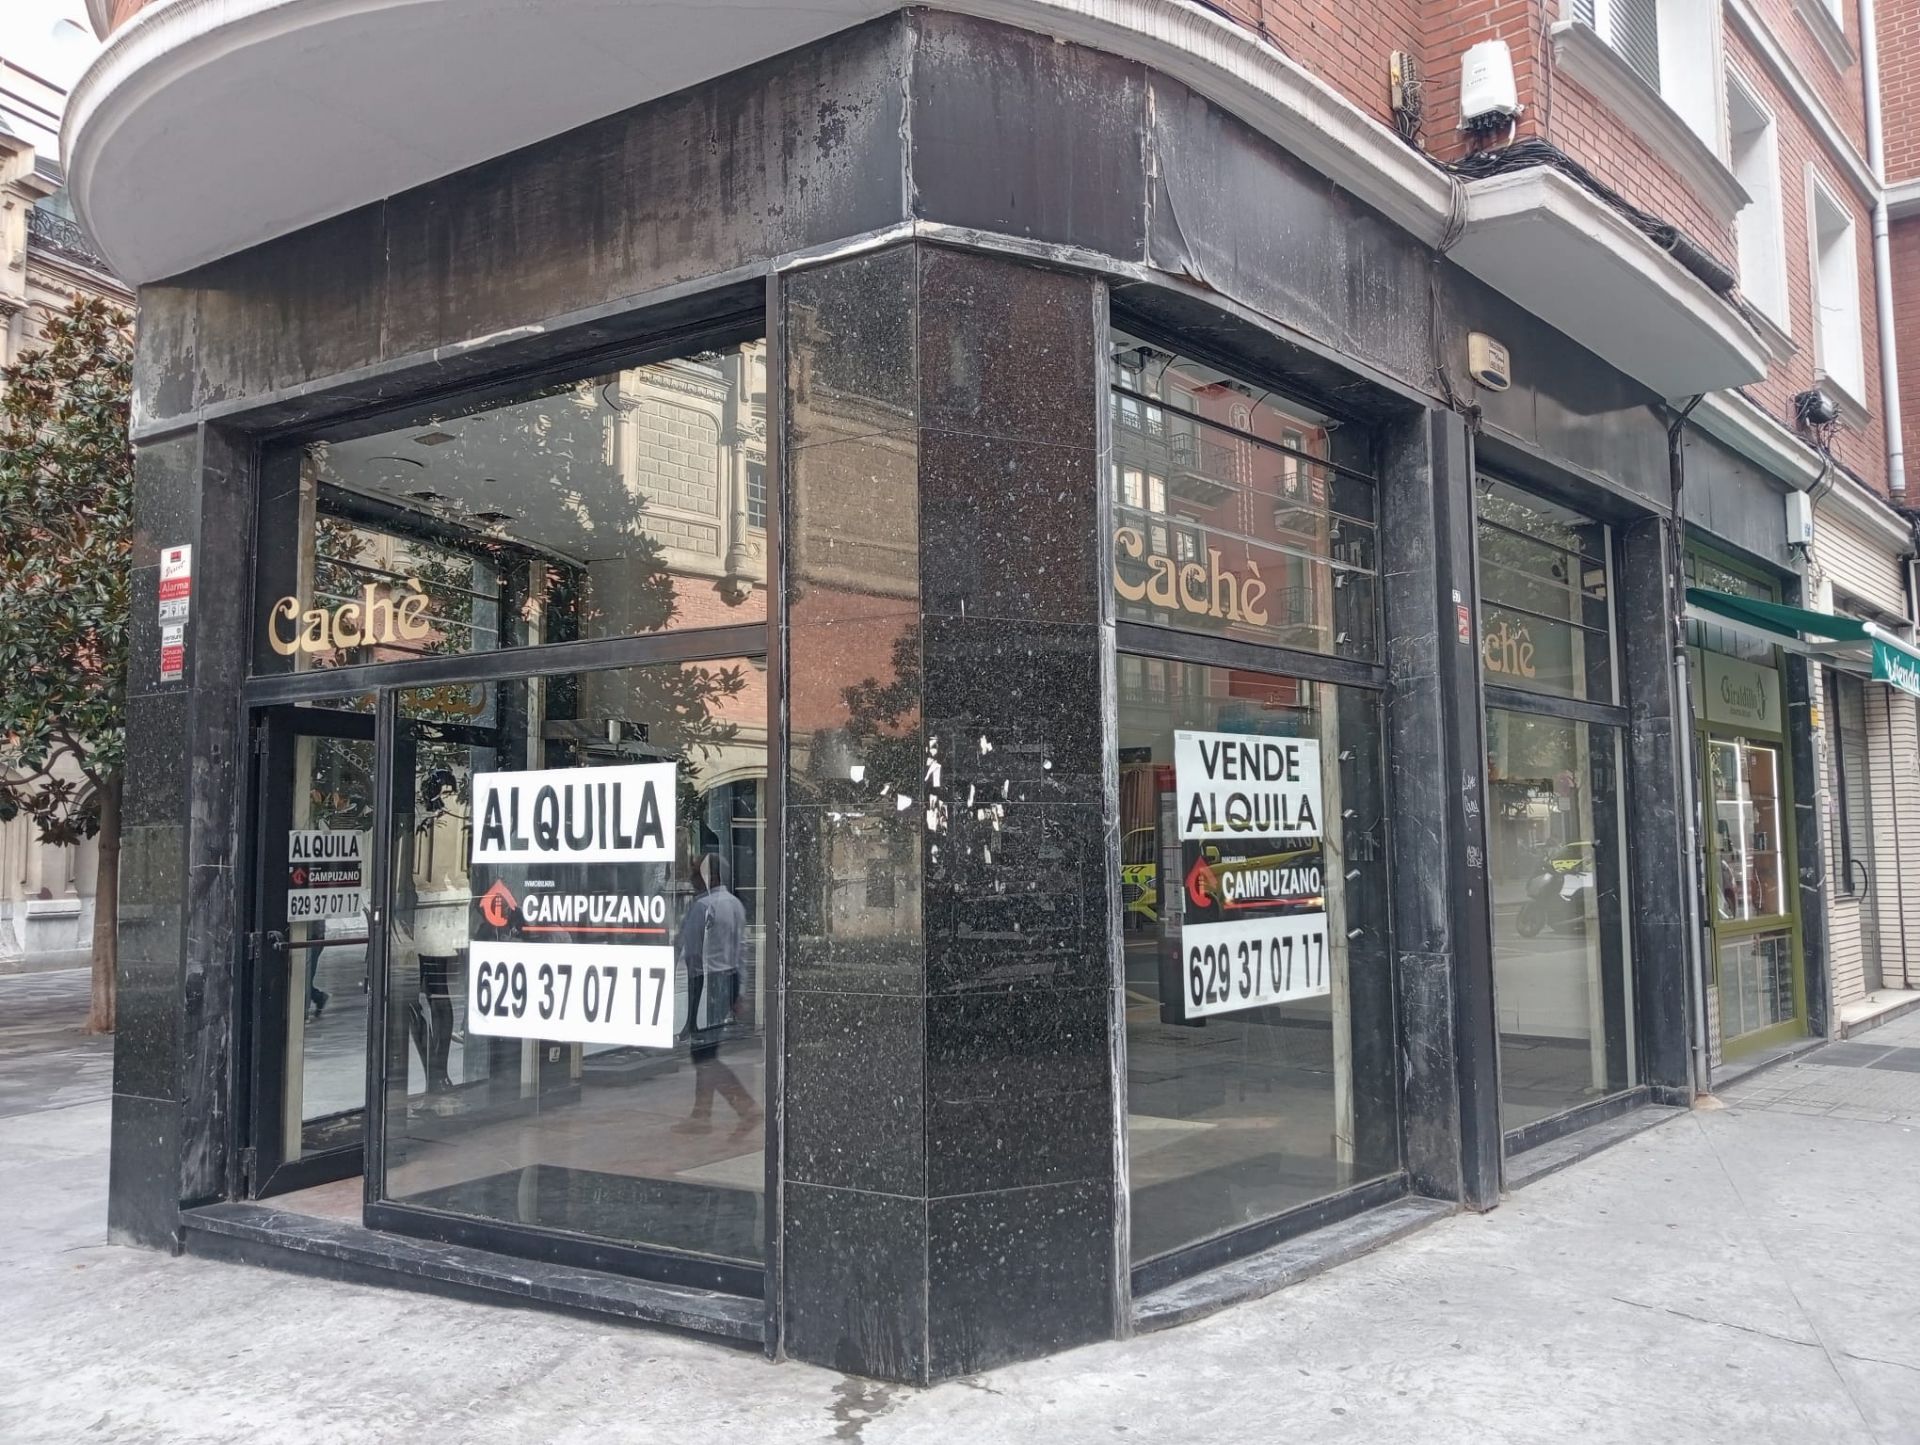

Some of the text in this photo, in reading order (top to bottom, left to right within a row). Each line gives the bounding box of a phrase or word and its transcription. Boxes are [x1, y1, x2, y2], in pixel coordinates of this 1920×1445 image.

[161, 582, 189, 593] Alarma
[1113, 526, 1268, 626] Cachè
[268, 578, 430, 656] Cachè
[1198, 739, 1300, 782] VENDE
[480, 780, 665, 851] ALQUILA
[1186, 792, 1317, 833] ALQUILA
[292, 835, 359, 858] ALQUILA
[309, 871, 359, 882] CAMPUZANO
[1222, 867, 1320, 898] CAMPUZANO
[291, 893, 360, 915] 629 37 07 17
[522, 894, 666, 924] CAMPUZANO
[1190, 933, 1323, 1006] 629 37 07 17
[477, 960, 666, 1026] 629 37 07 17
